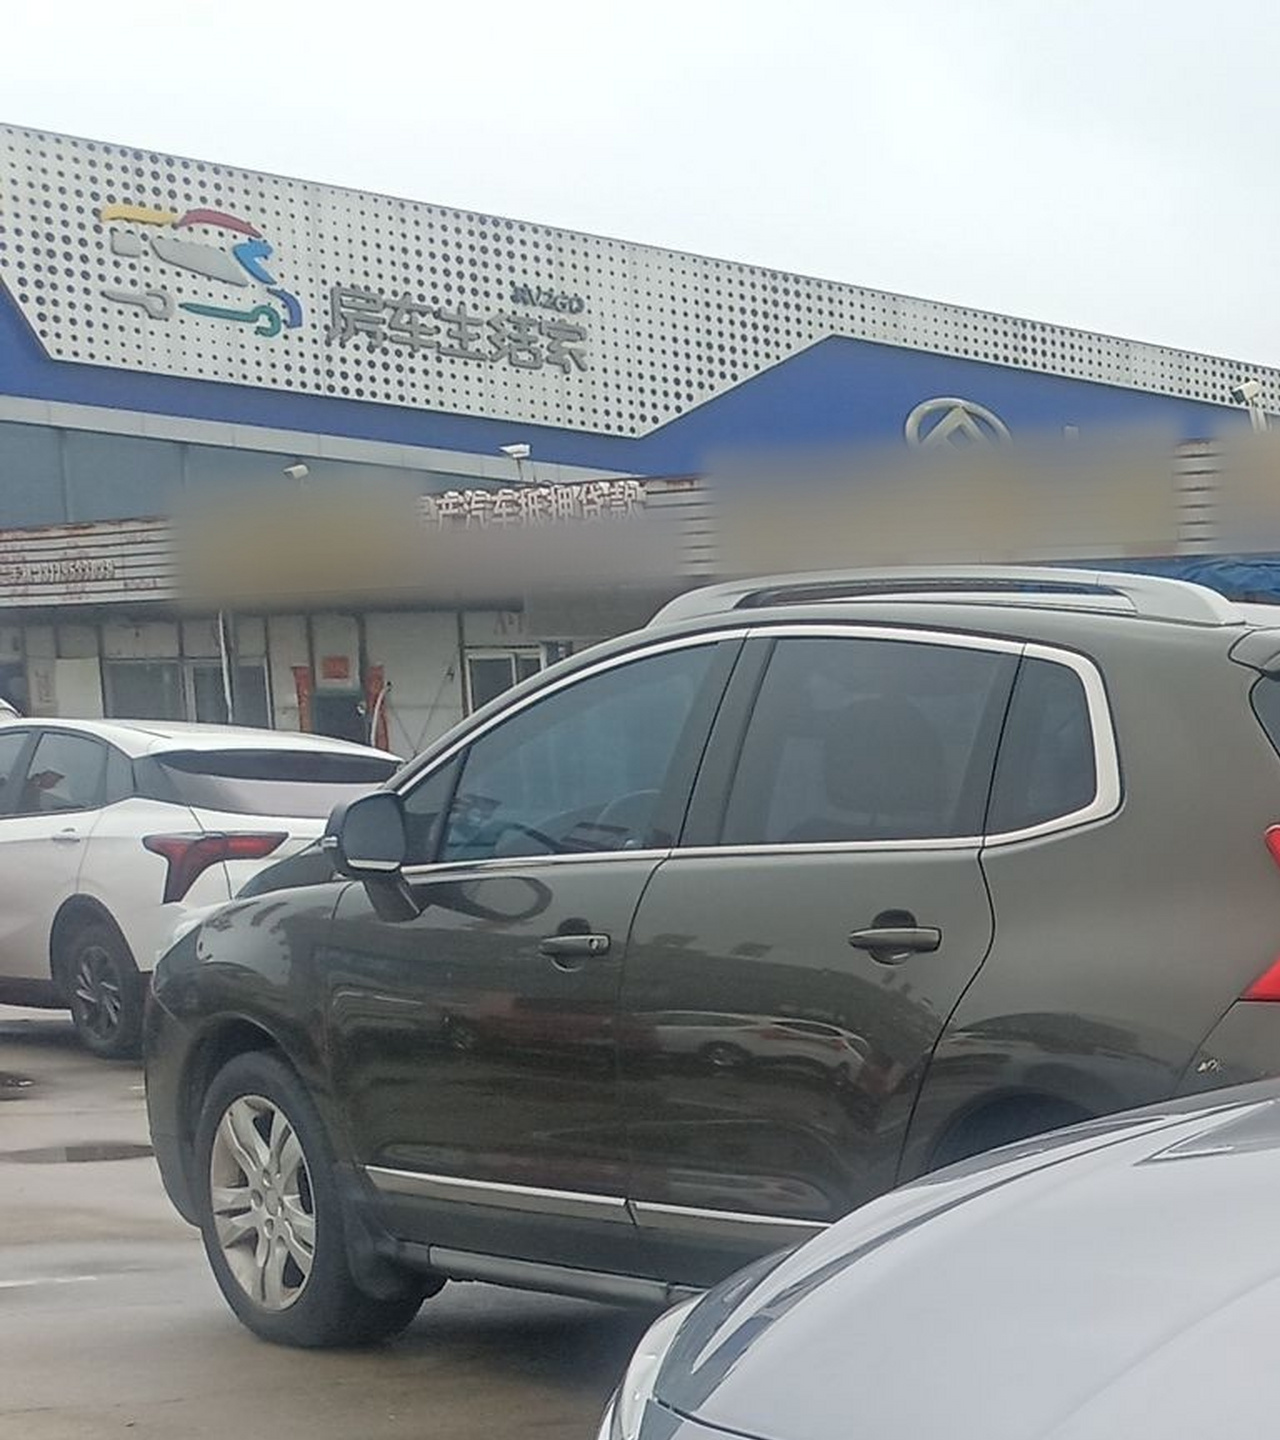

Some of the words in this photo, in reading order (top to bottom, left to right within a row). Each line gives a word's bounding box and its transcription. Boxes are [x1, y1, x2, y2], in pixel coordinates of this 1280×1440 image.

[325, 286, 588, 375] 房车生活家
